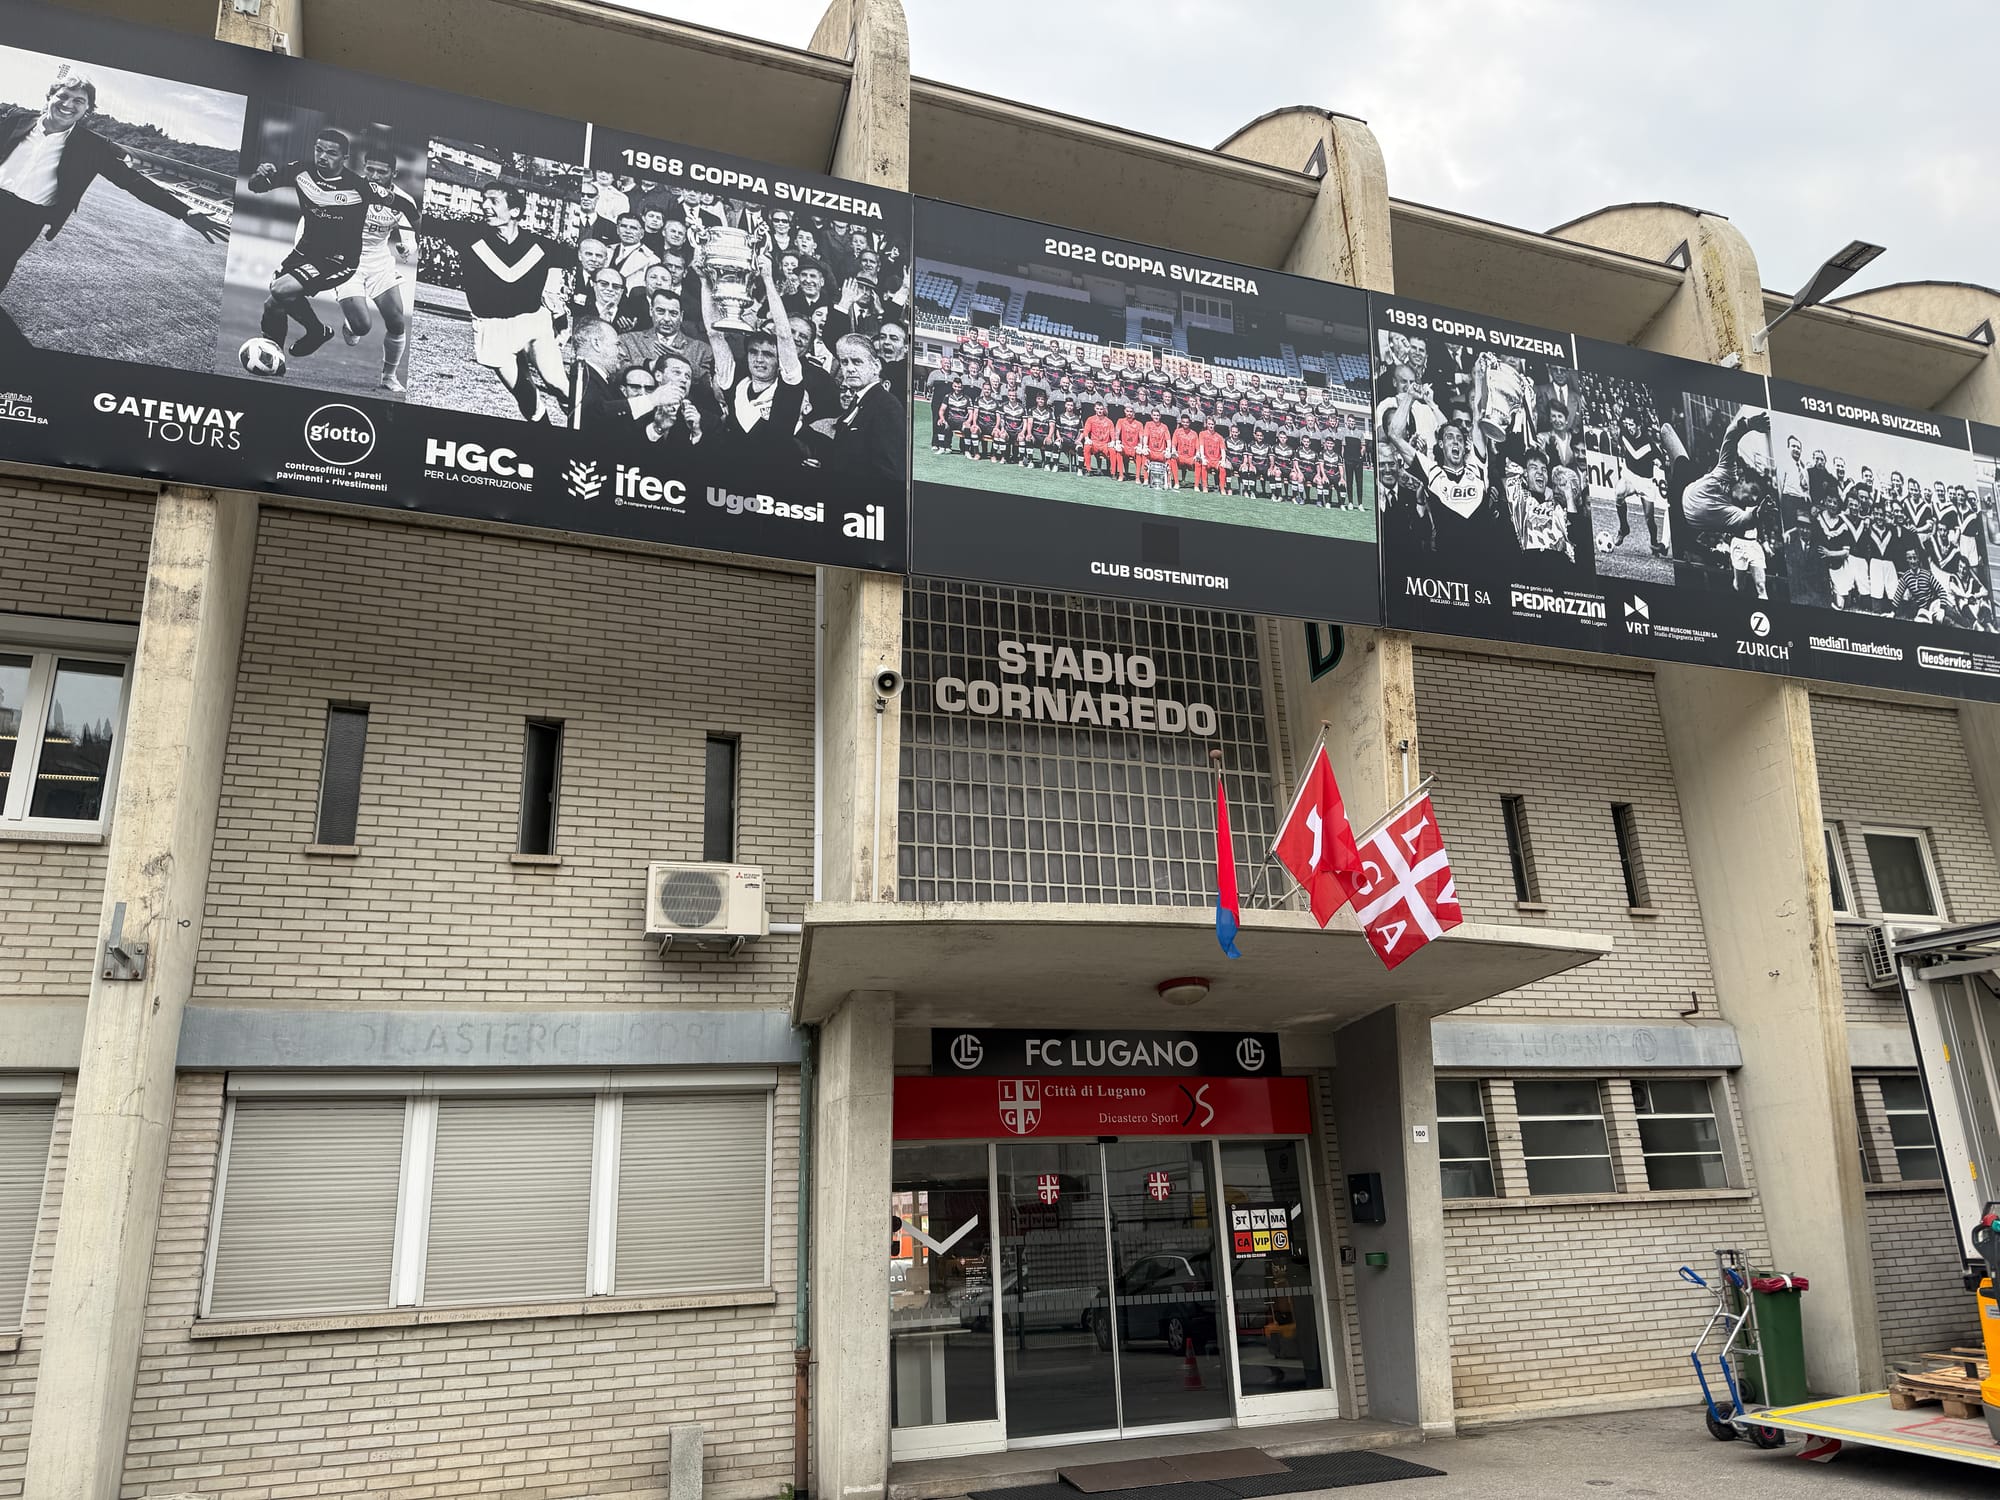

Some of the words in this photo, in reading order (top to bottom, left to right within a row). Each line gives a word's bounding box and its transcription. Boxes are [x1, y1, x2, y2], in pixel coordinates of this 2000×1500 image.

[622, 149, 683, 176] 1968
[690, 163, 768, 195] COPPA
[774, 182, 882, 220] SVIZZERA
[1045, 238, 1096, 263] 2022
[1102, 250, 1166, 277] COPPA
[1171, 264, 1259, 296] SVIZZERA
[1385, 308, 1428, 329] 1993
[1432, 317, 1487, 342] COPPA
[1489, 330, 1565, 359] SVIZZERA
[93, 392, 245, 430] GATEWAY
[1800, 396, 1833, 415] 1931
[1837, 404, 1880, 425] COPPA
[1882, 413, 1942, 438] SVIZZERA
[143, 418, 241, 451] TOURS
[309, 421, 371, 446] giotto
[276, 470, 323, 484] pavimenti
[332, 477, 388, 492] rivestimenti
[285, 462, 346, 476] controsoffitti
[354, 470, 382, 481] pareti
[424, 469, 444, 480] PER
[446, 473, 459, 482] LA
[461, 474, 533, 492] COSTRUZIONE
[615, 463, 687, 505] ifec
[706, 486, 825, 523] UgoBassi
[842, 503, 885, 541] ail
[1090, 561, 1130, 578] CLUB
[1133, 566, 1229, 590] SOSTENITORI
[1405, 576, 1469, 602] MONTI
[1474, 590, 1491, 605] SA
[1511, 590, 1606, 619] PEDRAZZINI
[1626, 621, 1650, 635] VRT
[1736, 640, 1790, 660] ZURICH
[1809, 635, 1850, 651] mediaTI
[1851, 641, 1903, 661] marketing
[1921, 650, 1972, 669] NeoService
[997, 640, 1157, 689] STADIO
[935, 676, 1218, 737] CORNAREDO
[1025, 1039, 1063, 1067] FC
[1071, 1039, 1199, 1068] LUGANO
[1044, 1084, 1077, 1097] Città
[1081, 1085, 1093, 1097] di
[1098, 1085, 1146, 1100] Lugano
[1099, 1112, 1148, 1124] Dicastero
[1151, 1112, 1179, 1125] Sport
[1235, 1216, 1247, 1225] ST
[1253, 1215, 1266, 1224] TV
[1271, 1215, 1285, 1223] MA
[1237, 1238, 1250, 1247] CA
[1254, 1237, 1270, 1246] VIP
